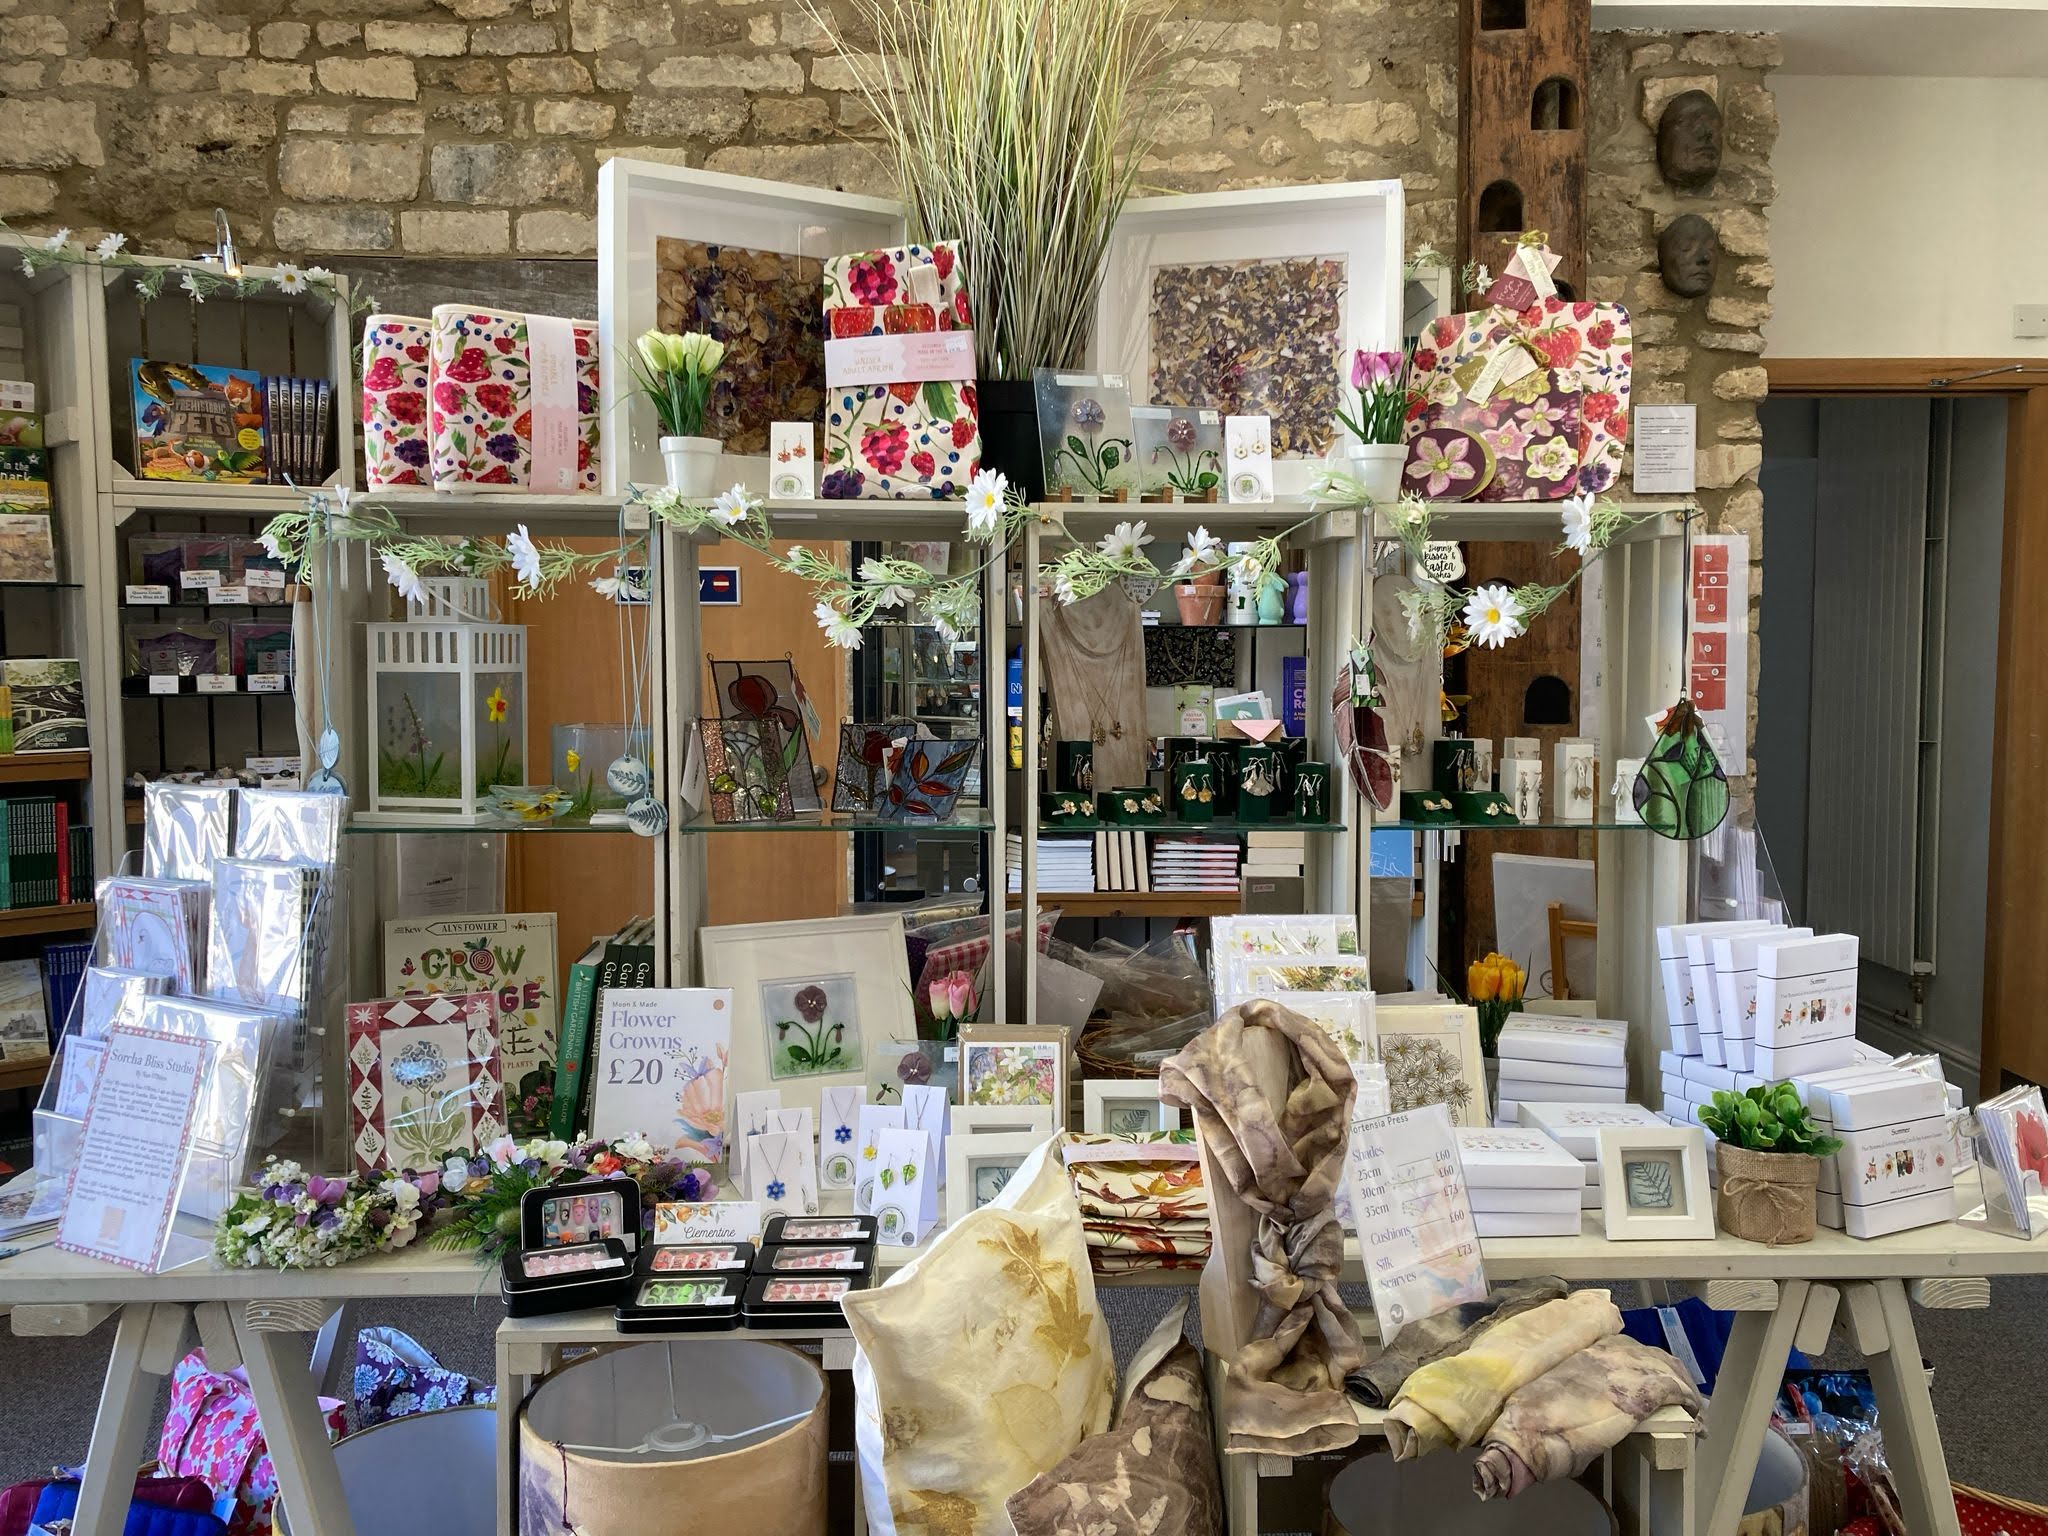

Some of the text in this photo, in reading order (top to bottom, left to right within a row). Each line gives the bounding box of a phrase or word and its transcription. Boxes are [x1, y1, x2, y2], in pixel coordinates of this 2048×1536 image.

[175, 399, 227, 415] PREHISTORIC
[171, 412, 232, 437] PETS
[1424, 560, 1456, 572] Easter
[441, 923, 498, 933] ALYS FOWLER
[421, 945, 527, 982] GROW
[565, 981, 584, 1060] BRITISH GARDENING
[611, 1010, 677, 1028] Flower
[609, 1032, 683, 1050] Crowns
[110, 1049, 143, 1066] Sorcha
[145, 1054, 164, 1070] Bliss
[165, 1058, 195, 1075] Studio
[507, 1061, 534, 1070] PLANTS
[608, 1058, 663, 1085] £20
[1387, 1114, 1409, 1126] Press
[1891, 1127, 1911, 1136] Summer
[1352, 1145, 1385, 1163] Shades
[1435, 1149, 1451, 1163] £60
[1358, 1168, 1382, 1183] 25cm
[1439, 1165, 1455, 1178] £60
[1361, 1185, 1386, 1200] 30cm
[1443, 1183, 1459, 1197] £73
[1365, 1203, 1390, 1218] 35cm
[1449, 1210, 1465, 1223] £60
[684, 1226, 737, 1239] Clementine
[1370, 1225, 1412, 1246] Cushions
[1457, 1243, 1473, 1257] £73
[1376, 1256, 1394, 1272] Silk
[1379, 1272, 1417, 1290] Scarves
